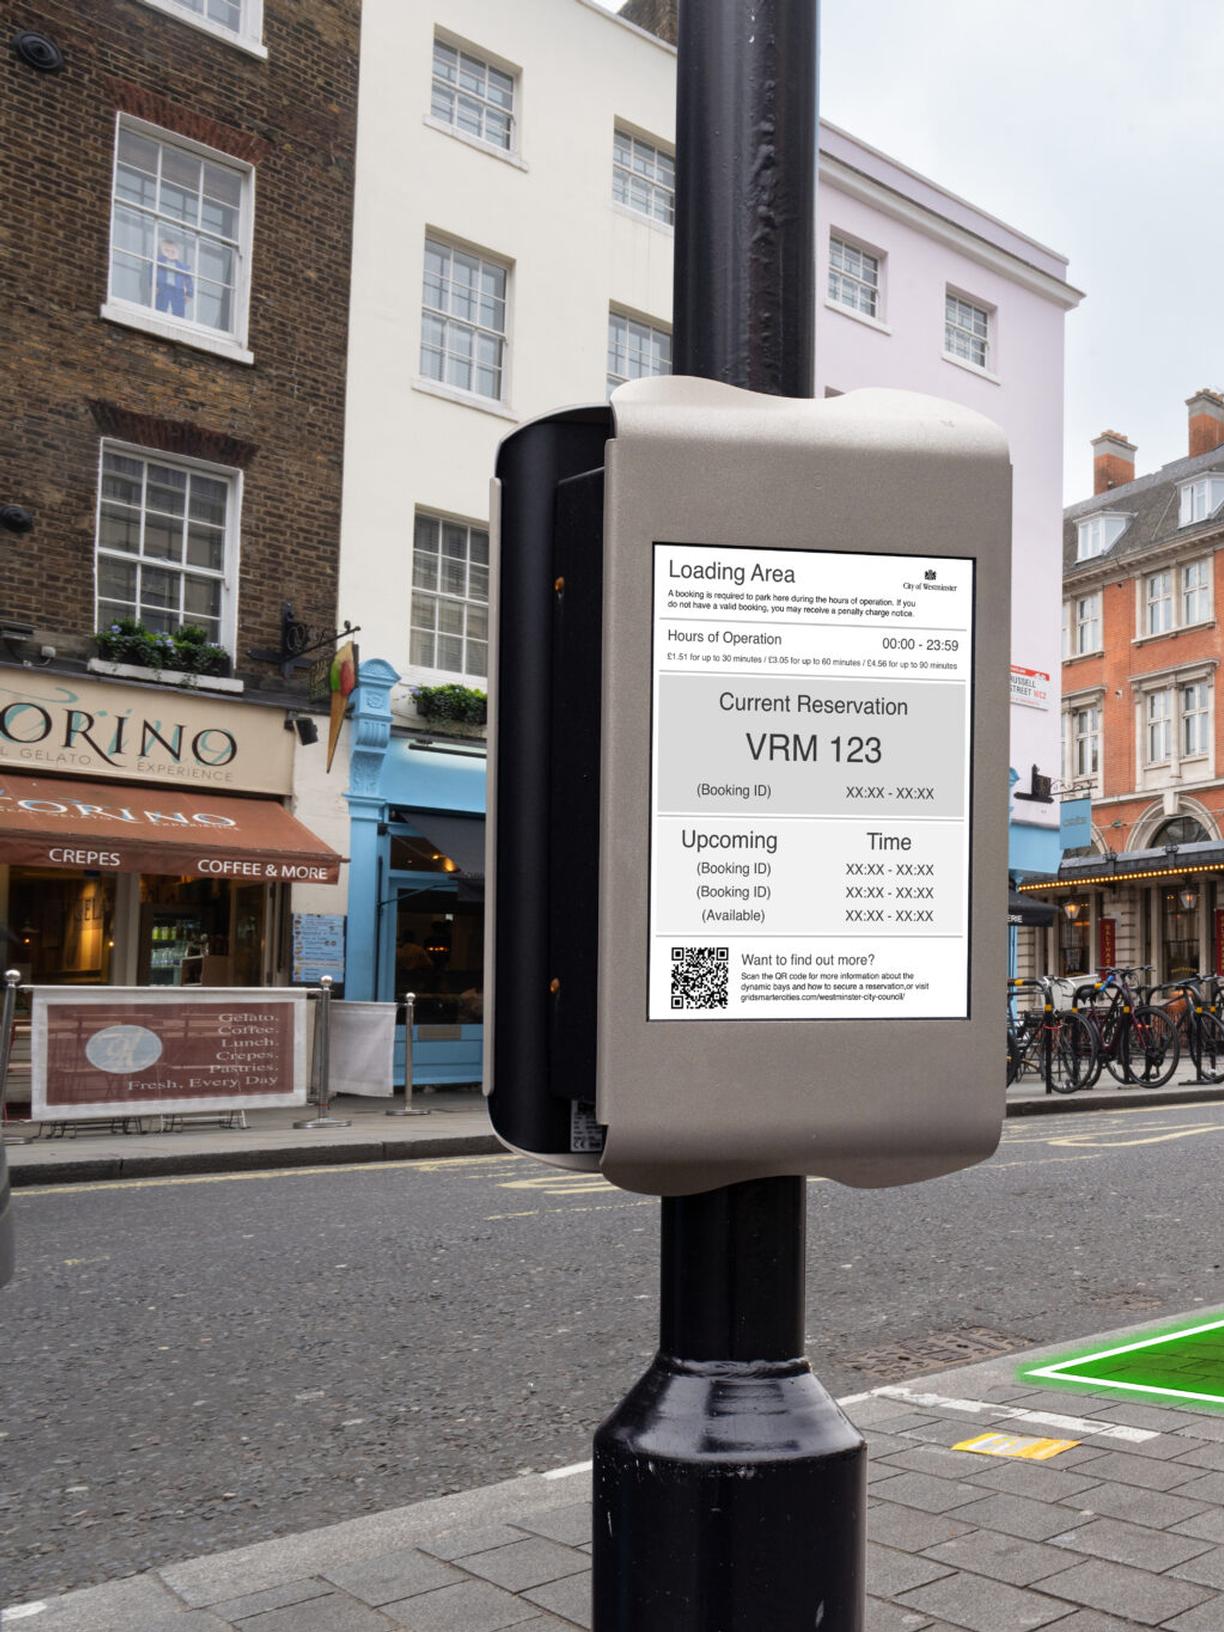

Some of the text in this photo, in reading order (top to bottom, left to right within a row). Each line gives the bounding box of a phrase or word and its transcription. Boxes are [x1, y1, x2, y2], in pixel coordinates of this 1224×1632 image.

[669, 559, 795, 585] Loading Area
[902, 582, 957, 591] City of Westminster
[675, 589, 704, 600] booking
[706, 591, 712, 599] is
[713, 591, 744, 601] required
[754, 593, 771, 602] park
[772, 593, 789, 602] here
[790, 595, 814, 604] during
[815, 595, 827, 603] the
[828, 596, 848, 604] hours
[850, 596, 857, 604] of
[858, 598, 893, 607] operation.
[896, 598, 901, 606] If
[902, 600, 915, 608] you
[667, 600, 678, 608] do
[679, 600, 691, 608] not
[692, 601, 711, 609] have
[719, 602, 736, 610] valid
[738, 603, 768, 613] booking,
[770, 605, 784, 613] you
[785, 606, 801, 614] may
[803, 605, 829, 614] receive
[837, 606, 863, 616] penalty
[864, 608, 889, 618] charge
[668, 629, 781, 647] Hours of Operation
[882, 637, 915, 650] 00:00
[926, 638, 958, 651] 23:59
[689, 652, 700, 661] for
[701, 654, 711, 662] up
[712, 654, 720, 662] to
[732, 655, 762, 663] minutes
[790, 656, 800, 664] for
[801, 657, 811, 666] up
[812, 657, 820, 665] to
[832, 658, 861, 666] minutes
[899, 661, 909, 669] up
[719, 691, 907, 715] Current Reservation
[745, 732, 881, 763] VRM 123
[20, 748, 233, 783] GELATO EXPERIENCE
[696, 783, 771, 799] (Booking ID)
[846, 786, 884, 798] XX:XX
[896, 787, 934, 799] XX:XX
[0, 797, 237, 827] ORINO
[681, 829, 777, 853] Upcoming
[866, 832, 911, 850] Time
[49, 847, 121, 867] CREPES
[197, 859, 329, 881] COFFEE & MORE
[696, 861, 771, 877] (Booking ID)
[845, 863, 884, 875] XX:XX
[896, 863, 934, 875] XX:XX
[696, 885, 770, 900] (Booking ID)
[845, 886, 884, 898] XX:XX
[895, 887, 933, 898] XX:XX
[701, 909, 765, 923] (Available)
[845, 909, 884, 921] XX:XX
[895, 910, 933, 921] XX:XX
[741, 953, 875, 966] Want to find out more?
[741, 971, 760, 980] Scan
[761, 972, 773, 980] the
[774, 971, 787, 980] QR
[788, 972, 807, 980] code
[808, 972, 818, 980] for
[839, 971, 879, 980] information
[740, 983, 771, 992] dynamic
[772, 983, 790, 991] bays
[807, 982, 822, 990] how
[189, 1078, 239, 1089] Every
[245, 1076, 278, 1086] Day
